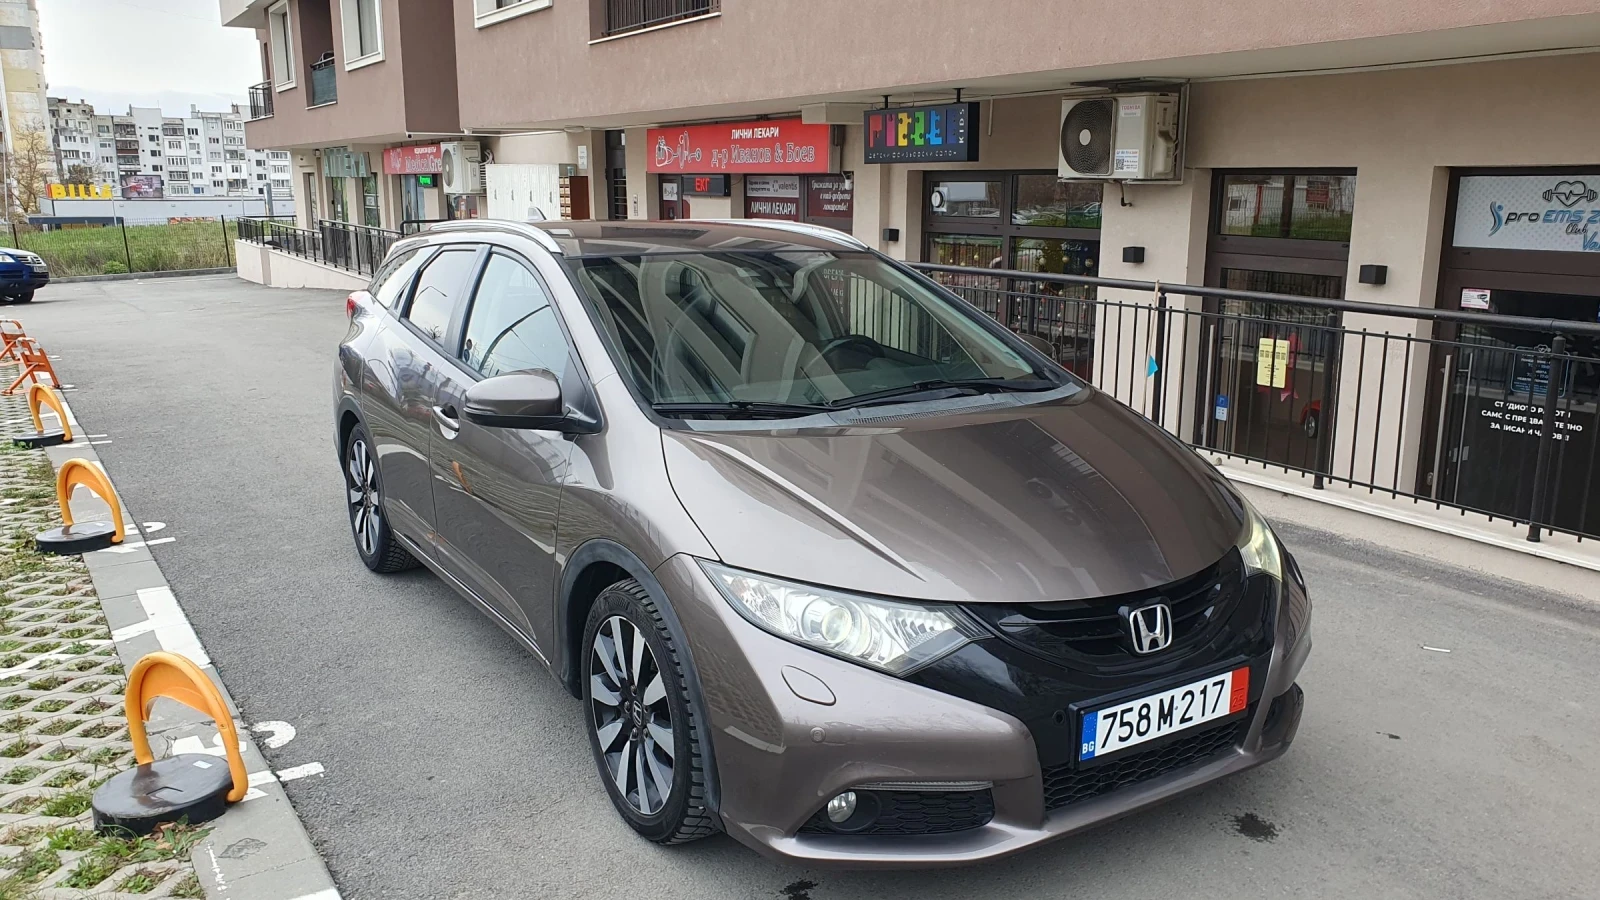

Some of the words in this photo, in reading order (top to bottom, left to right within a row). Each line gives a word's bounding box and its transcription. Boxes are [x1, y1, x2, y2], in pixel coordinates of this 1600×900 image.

[731, 128, 752, 140] ЛИЧНИ
[753, 127, 779, 139] ЛЕКАРИ
[711, 149, 728, 168] д-р
[730, 144, 771, 163] Иванов
[774, 143, 783, 163] &
[786, 142, 815, 163] Боев
[51, 184, 112, 198] BILLA
[695, 177, 710, 192] ЕКГ
[778, 182, 798, 190] valentis
[750, 201, 771, 214] ЛИЧНИ
[771, 202, 796, 215] ЛЕКАРИ
[1504, 212, 1540, 226] pro
[1542, 209, 1583, 223] EMS
[1586, 209, 1600, 223] Z
[1565, 222, 1588, 235] Club
[1494, 401, 1537, 414] СТДИОТО
[1512, 414, 1583, 432] ПРЕВАТЕНО
[1082, 741, 1095, 754] BG
